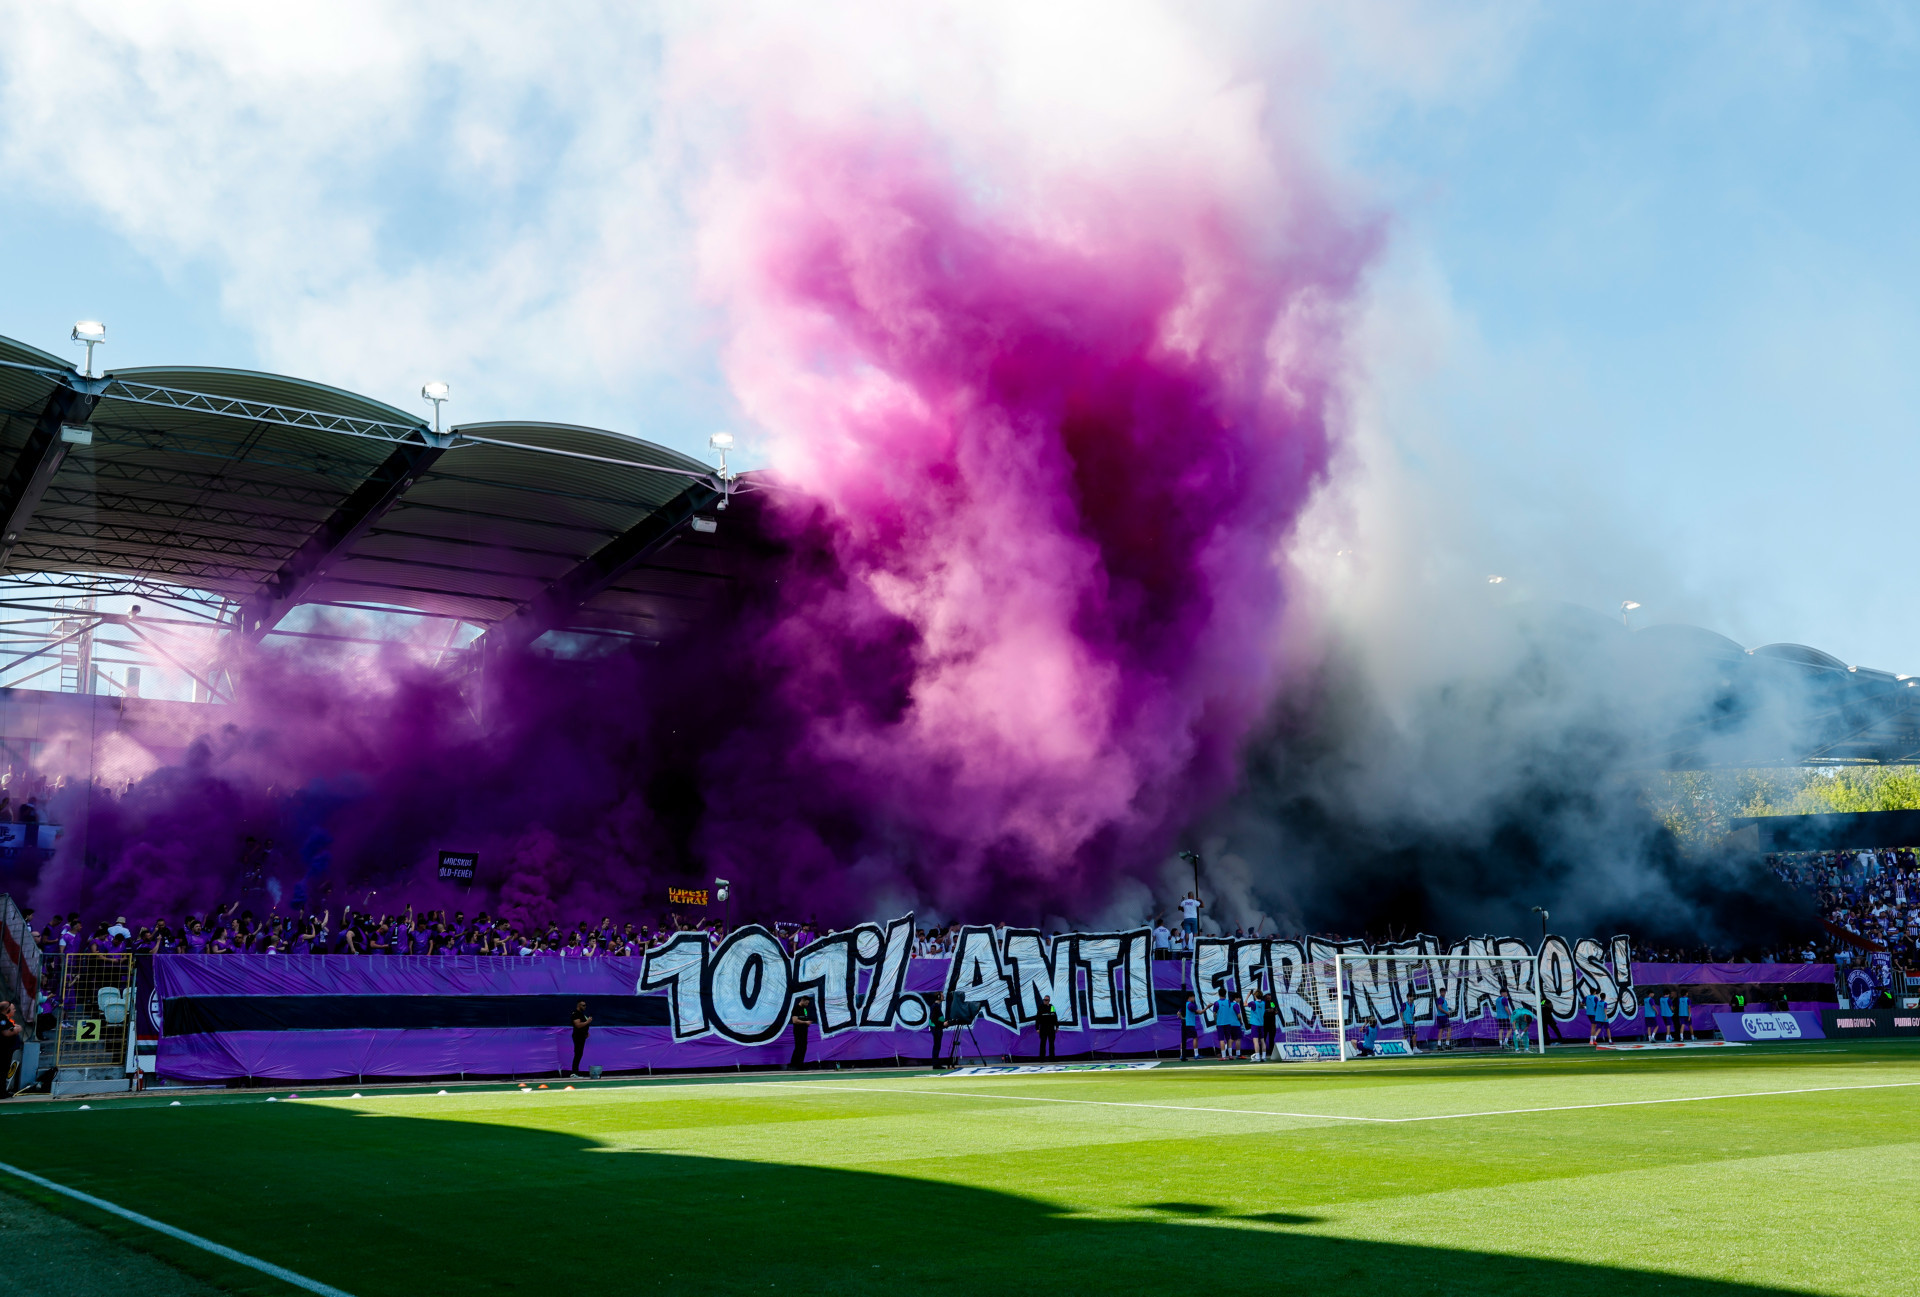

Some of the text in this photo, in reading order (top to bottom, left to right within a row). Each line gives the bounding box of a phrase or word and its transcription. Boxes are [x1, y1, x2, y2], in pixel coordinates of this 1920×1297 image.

[669, 895, 708, 906] ULTRAS
[944, 924, 1157, 1035] ANTI
[1755, 1017, 1797, 1034] fizz liga
[1836, 1018, 1854, 1029] PUMA
[1893, 1017, 1912, 1027] PUMA
[80, 1022, 97, 1040] 2
[1374, 1042, 1407, 1055] PMIX
